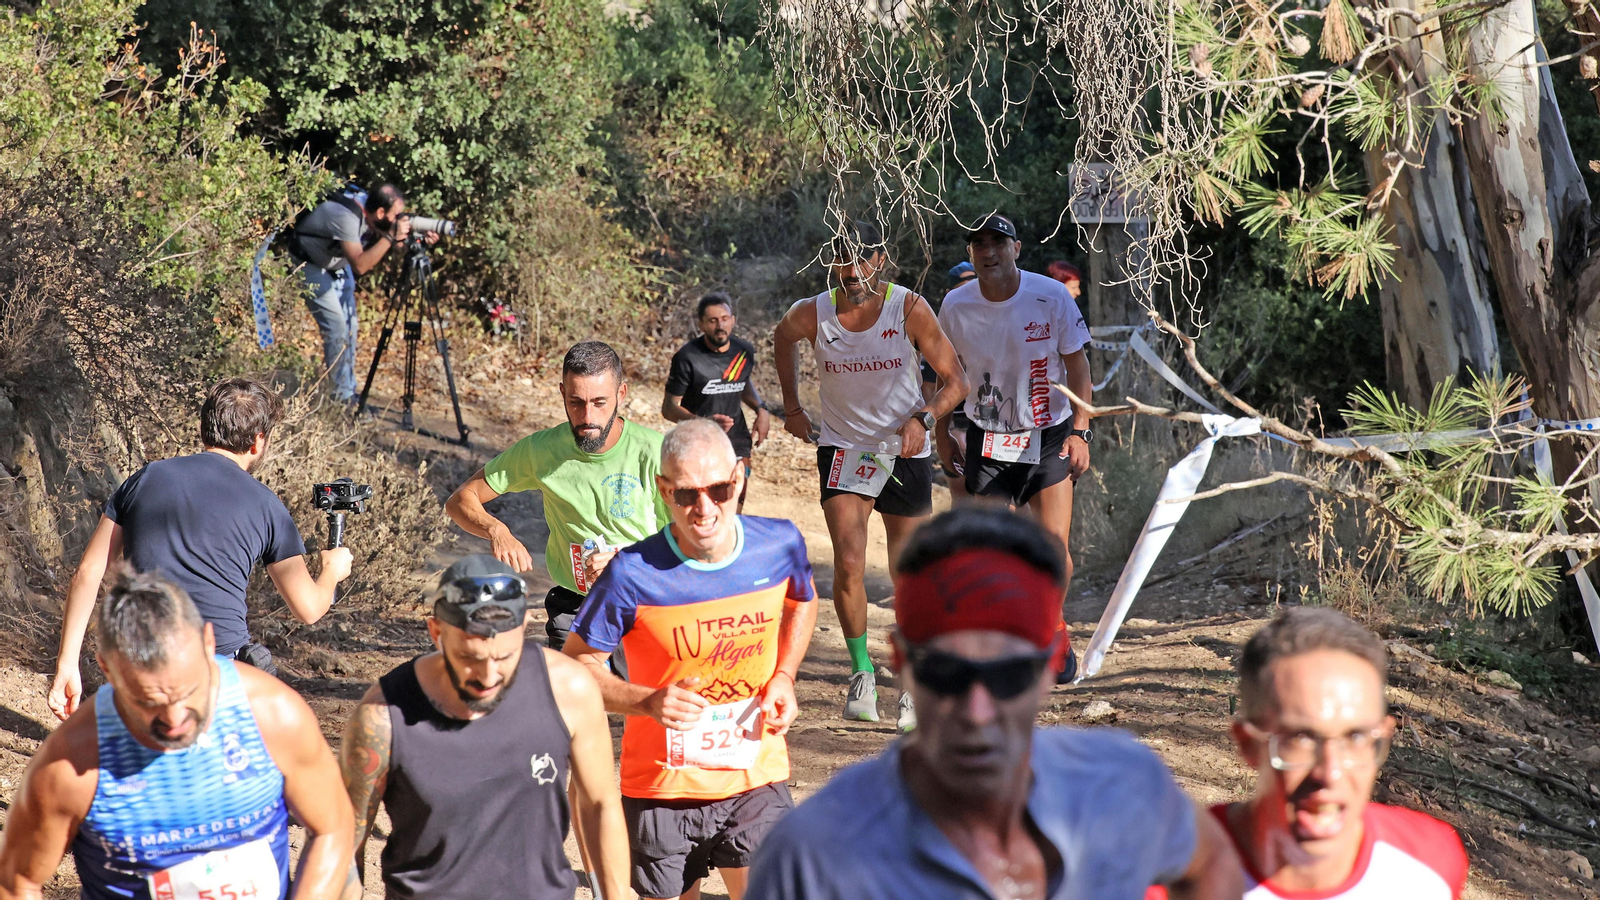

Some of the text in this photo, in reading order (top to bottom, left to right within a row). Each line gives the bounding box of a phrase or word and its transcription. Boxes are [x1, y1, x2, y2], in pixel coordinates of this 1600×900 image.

[824, 357, 903, 374] FUNDADOR
[843, 355, 881, 363] BODEGAS
[1030, 357, 1052, 428] ZEBULON
[985, 430, 994, 453] PIRAT
[1002, 434, 1031, 449] 243
[831, 455, 844, 483] PIRATA
[855, 464, 877, 480] 47
[573, 552, 585, 586] PIRATA
[700, 611, 773, 632] TRAIL
[712, 626, 766, 640] VILLA DE
[698, 639, 764, 670] Algar
[671, 730, 684, 761] PIRAT
[700, 724, 747, 751] 529
